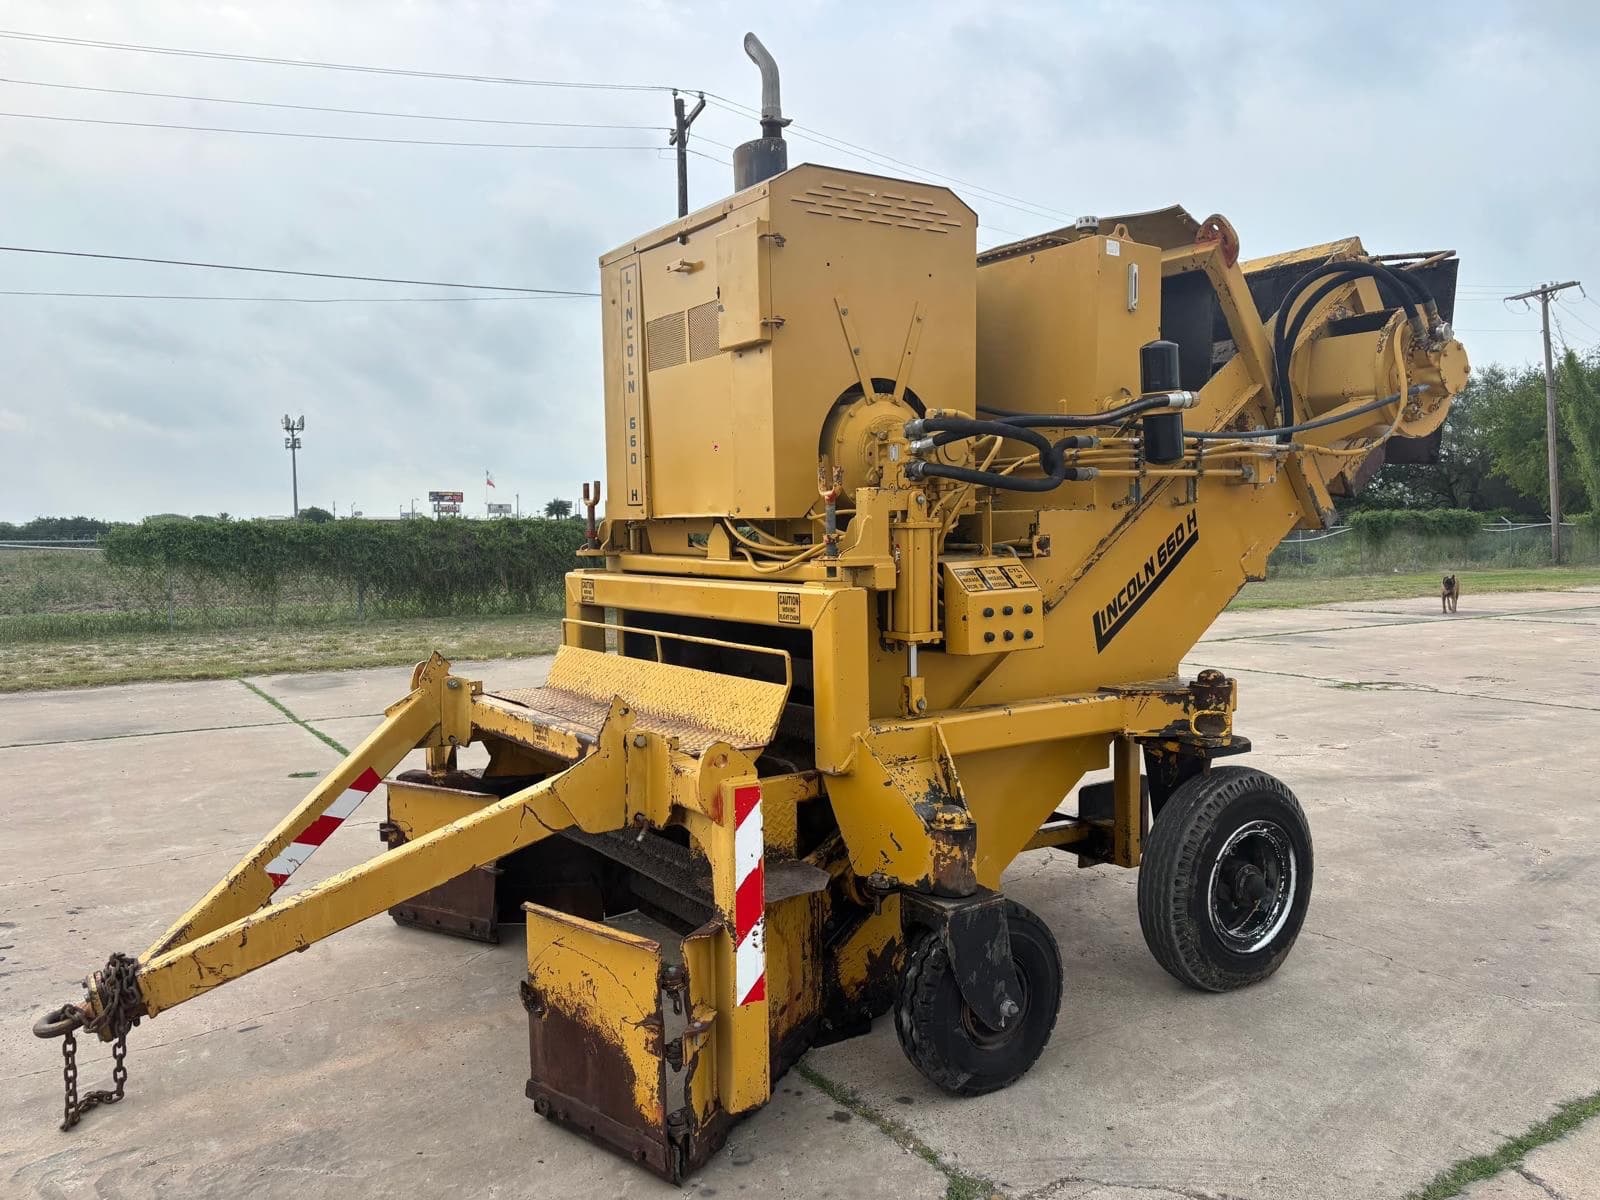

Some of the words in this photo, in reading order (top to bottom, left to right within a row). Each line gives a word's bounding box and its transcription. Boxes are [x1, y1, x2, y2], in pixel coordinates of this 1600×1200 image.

[625, 271, 635, 393] LINCOLN
[629, 417, 637, 465] 660
[631, 489, 638, 501] H
[779, 595, 799, 605] CAUTION
[1092, 556, 1155, 654] LINCOLN
[1157, 523, 1184, 568] 660
[1186, 508, 1197, 533] H
